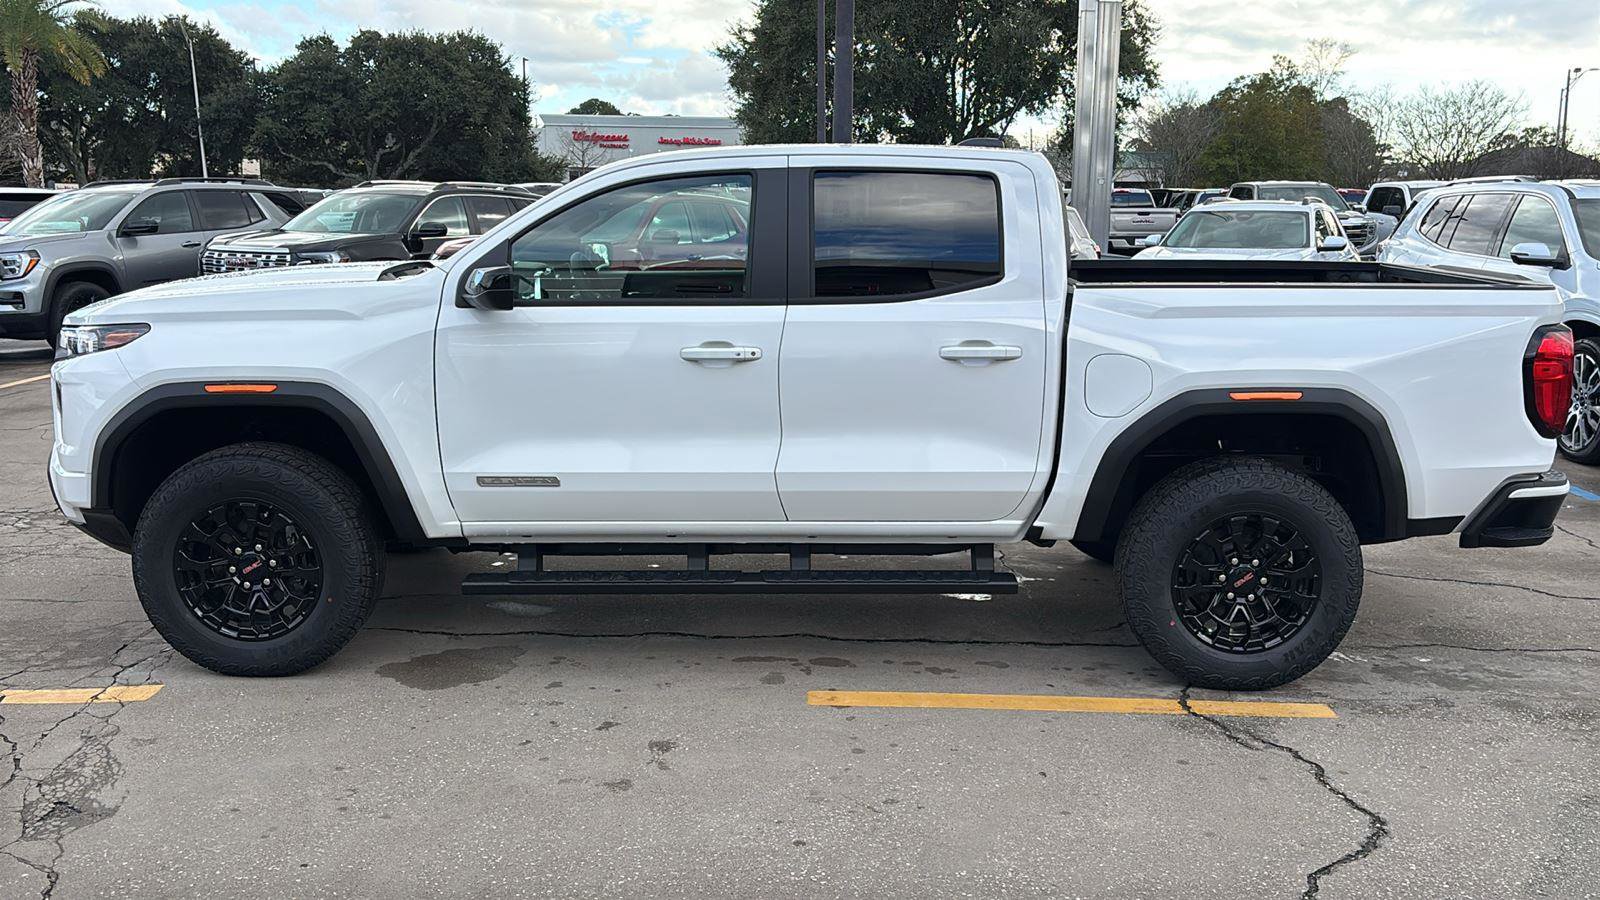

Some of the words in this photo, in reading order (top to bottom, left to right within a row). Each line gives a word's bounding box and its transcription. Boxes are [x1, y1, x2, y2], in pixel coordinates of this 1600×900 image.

[572, 131, 629, 144] Walgreens
[242, 559, 263, 574] GMC
[1233, 572, 1254, 588] GMC
